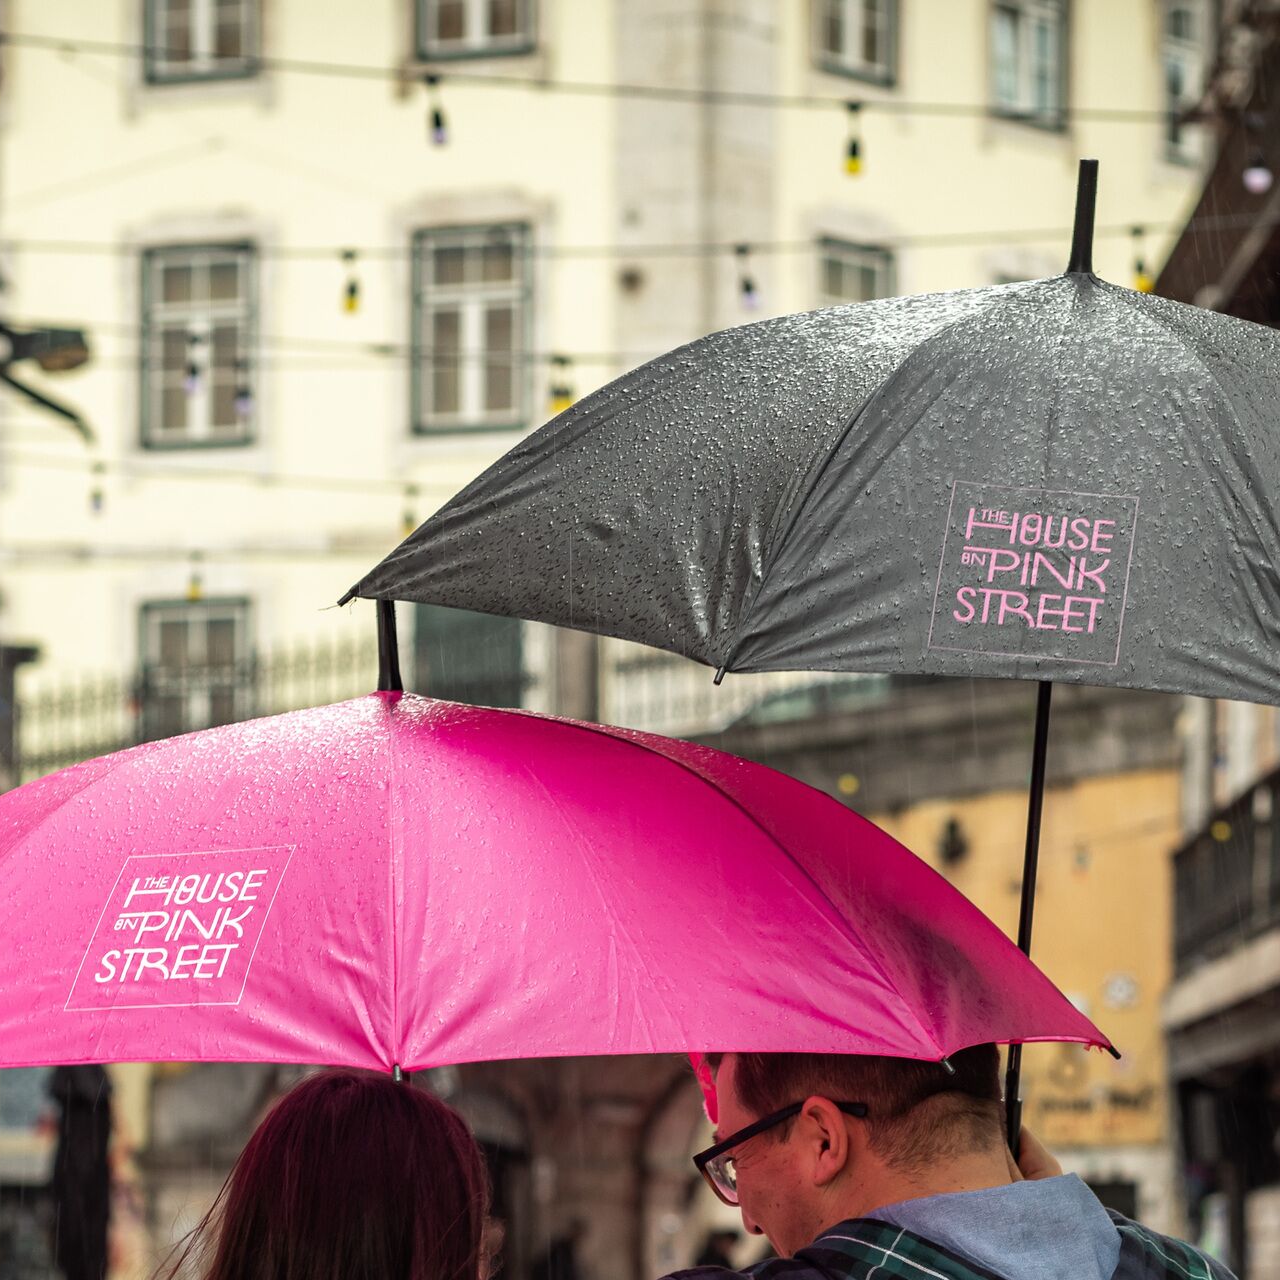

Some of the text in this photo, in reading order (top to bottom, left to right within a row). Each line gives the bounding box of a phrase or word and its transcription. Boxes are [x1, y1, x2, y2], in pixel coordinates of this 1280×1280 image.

[965, 507, 1116, 553] THE HOUSE
[960, 545, 1110, 593] ON PINK
[952, 586, 1104, 633] STREET
[123, 869, 268, 908] THE HOUSE
[113, 905, 254, 944] ON PINK
[94, 943, 239, 983] STREET
